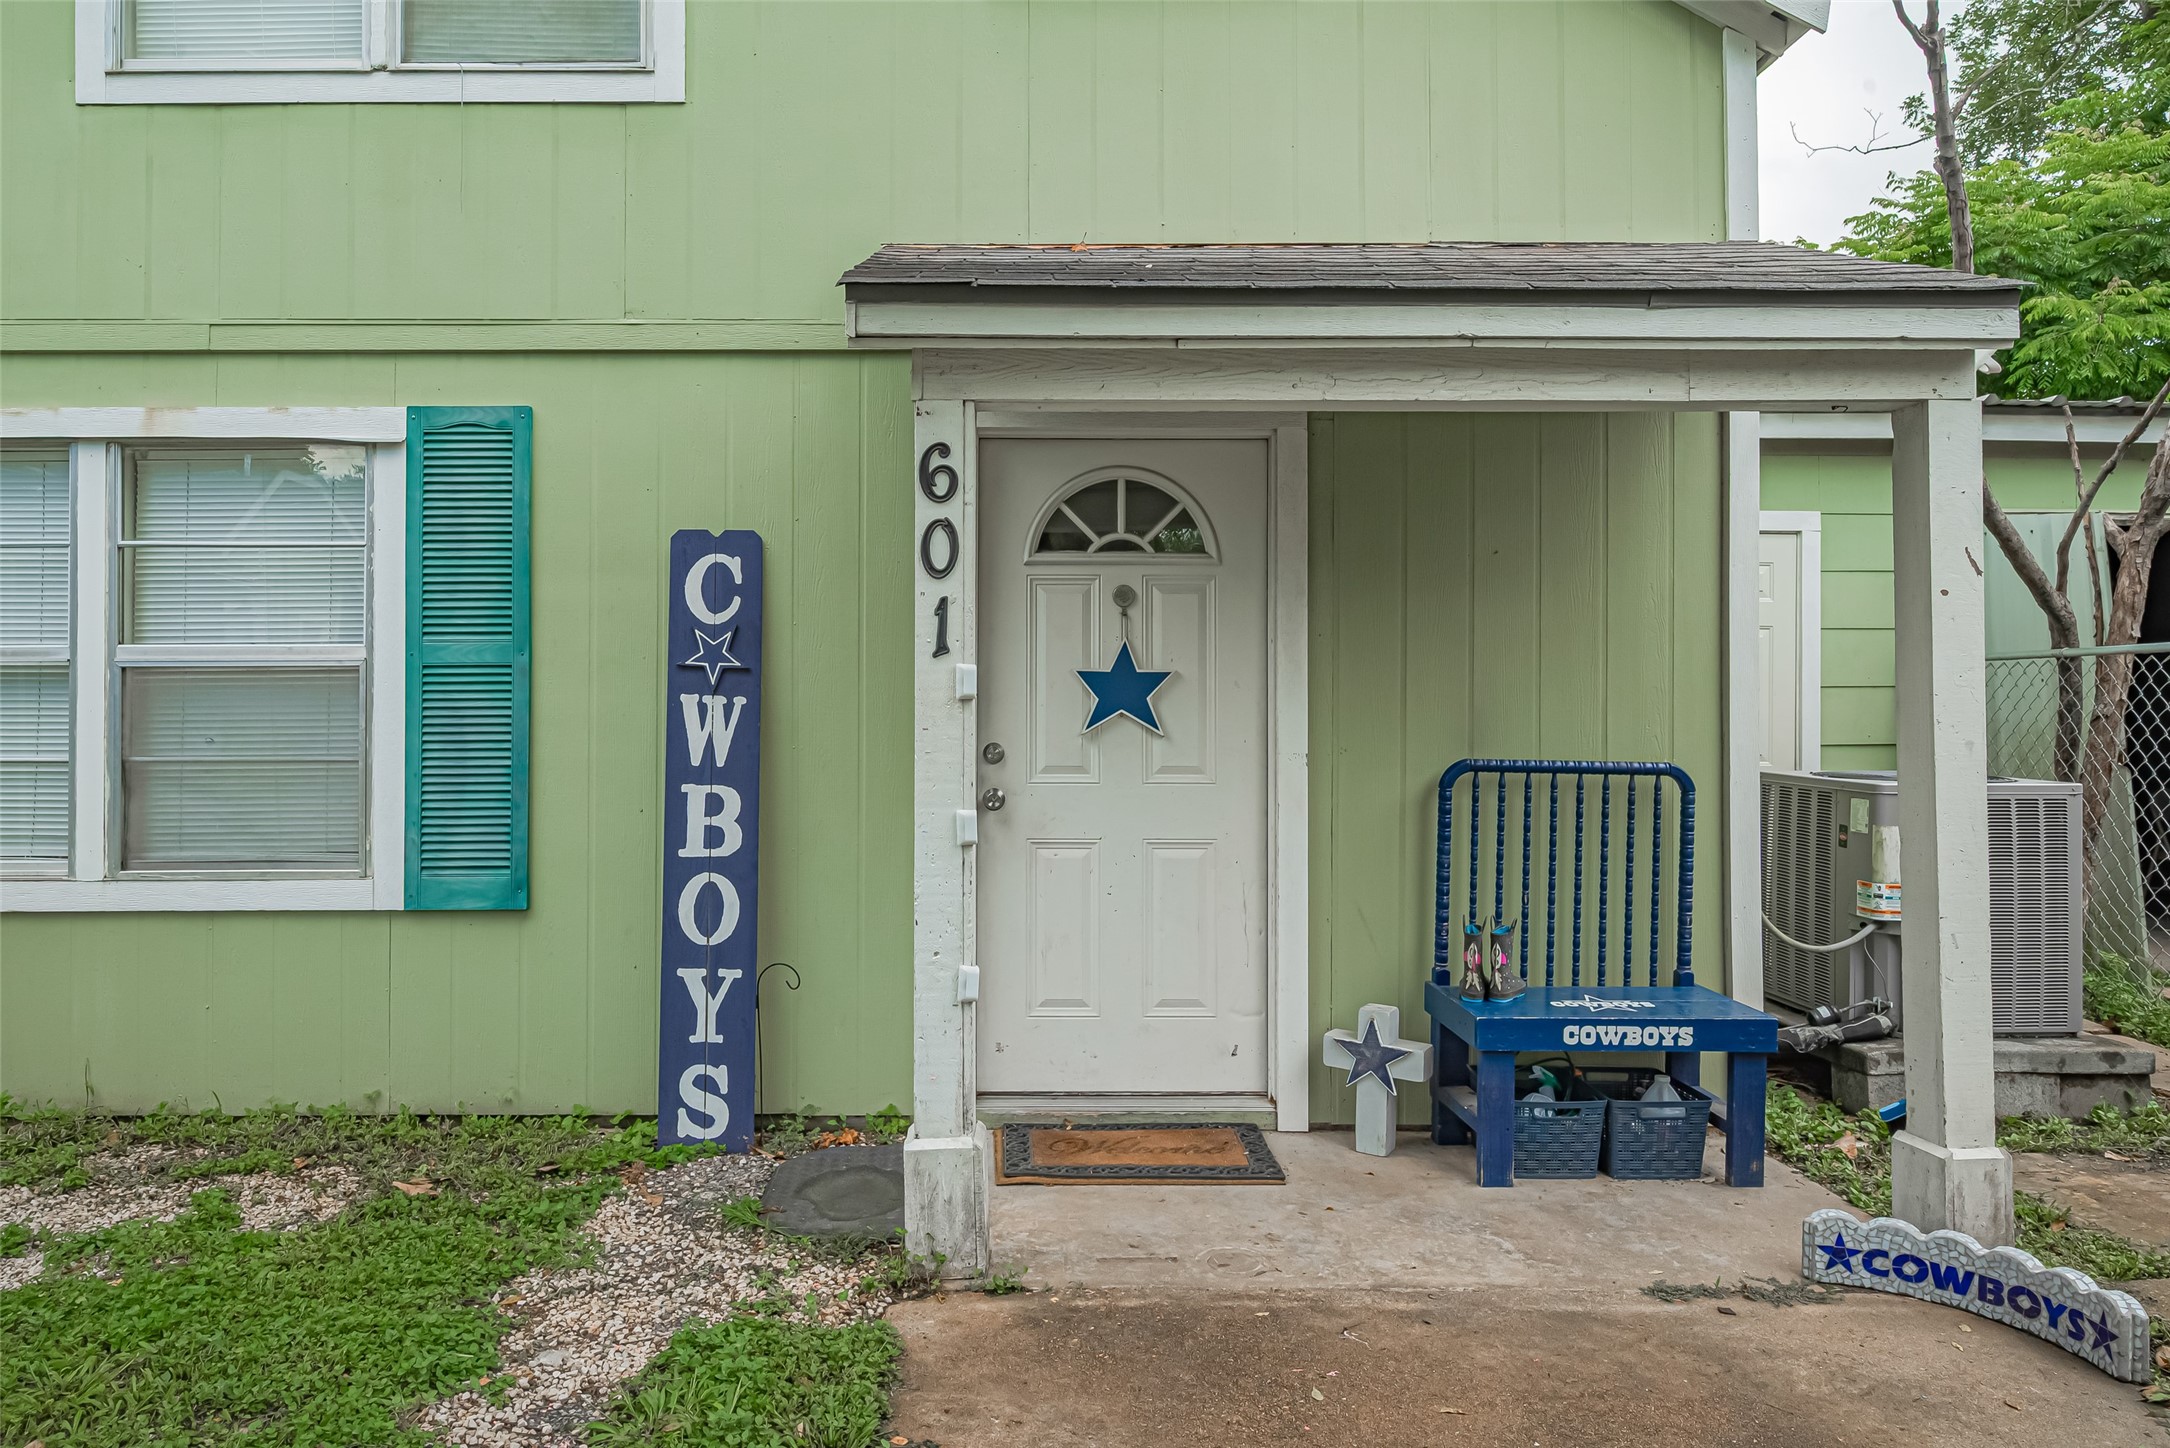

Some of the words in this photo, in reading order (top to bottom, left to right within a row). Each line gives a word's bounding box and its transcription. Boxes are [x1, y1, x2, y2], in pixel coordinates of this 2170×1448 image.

[918, 441, 960, 659] 601
[677, 553, 747, 1141] CWBOYS
[1562, 1025, 1694, 1047] COWBOYS
[1861, 1248, 2086, 1342] COWBOYS
